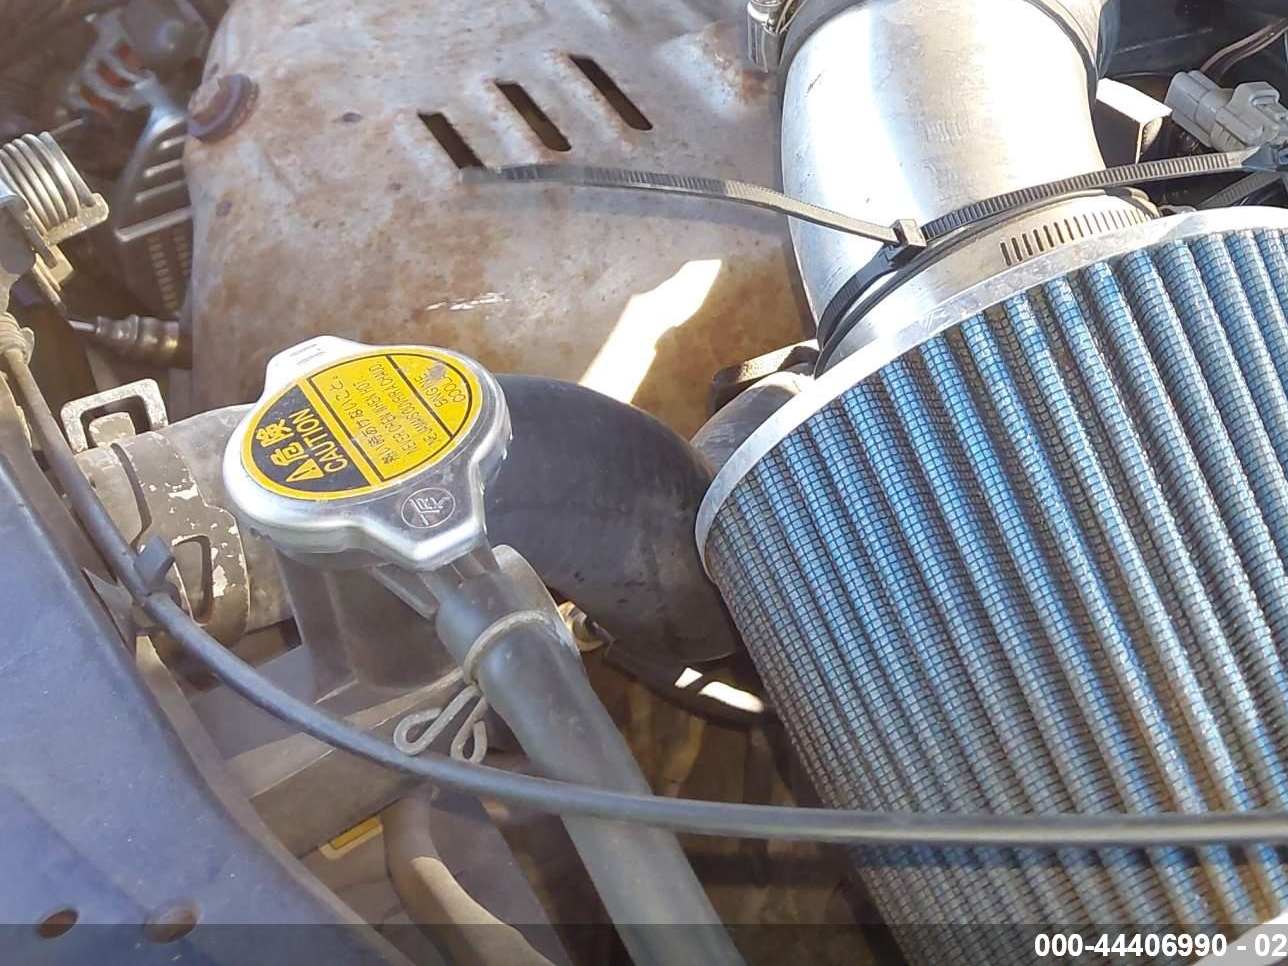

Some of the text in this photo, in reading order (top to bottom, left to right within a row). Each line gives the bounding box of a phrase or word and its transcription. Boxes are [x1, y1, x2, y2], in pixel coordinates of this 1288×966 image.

[363, 392, 388, 414] WHEN
[413, 372, 449, 408] ENGINE
[377, 411, 403, 433] OPEN
[254, 419, 311, 470] 危険
[285, 407, 351, 474] CAUTION
[391, 429, 419, 455] NEVER
